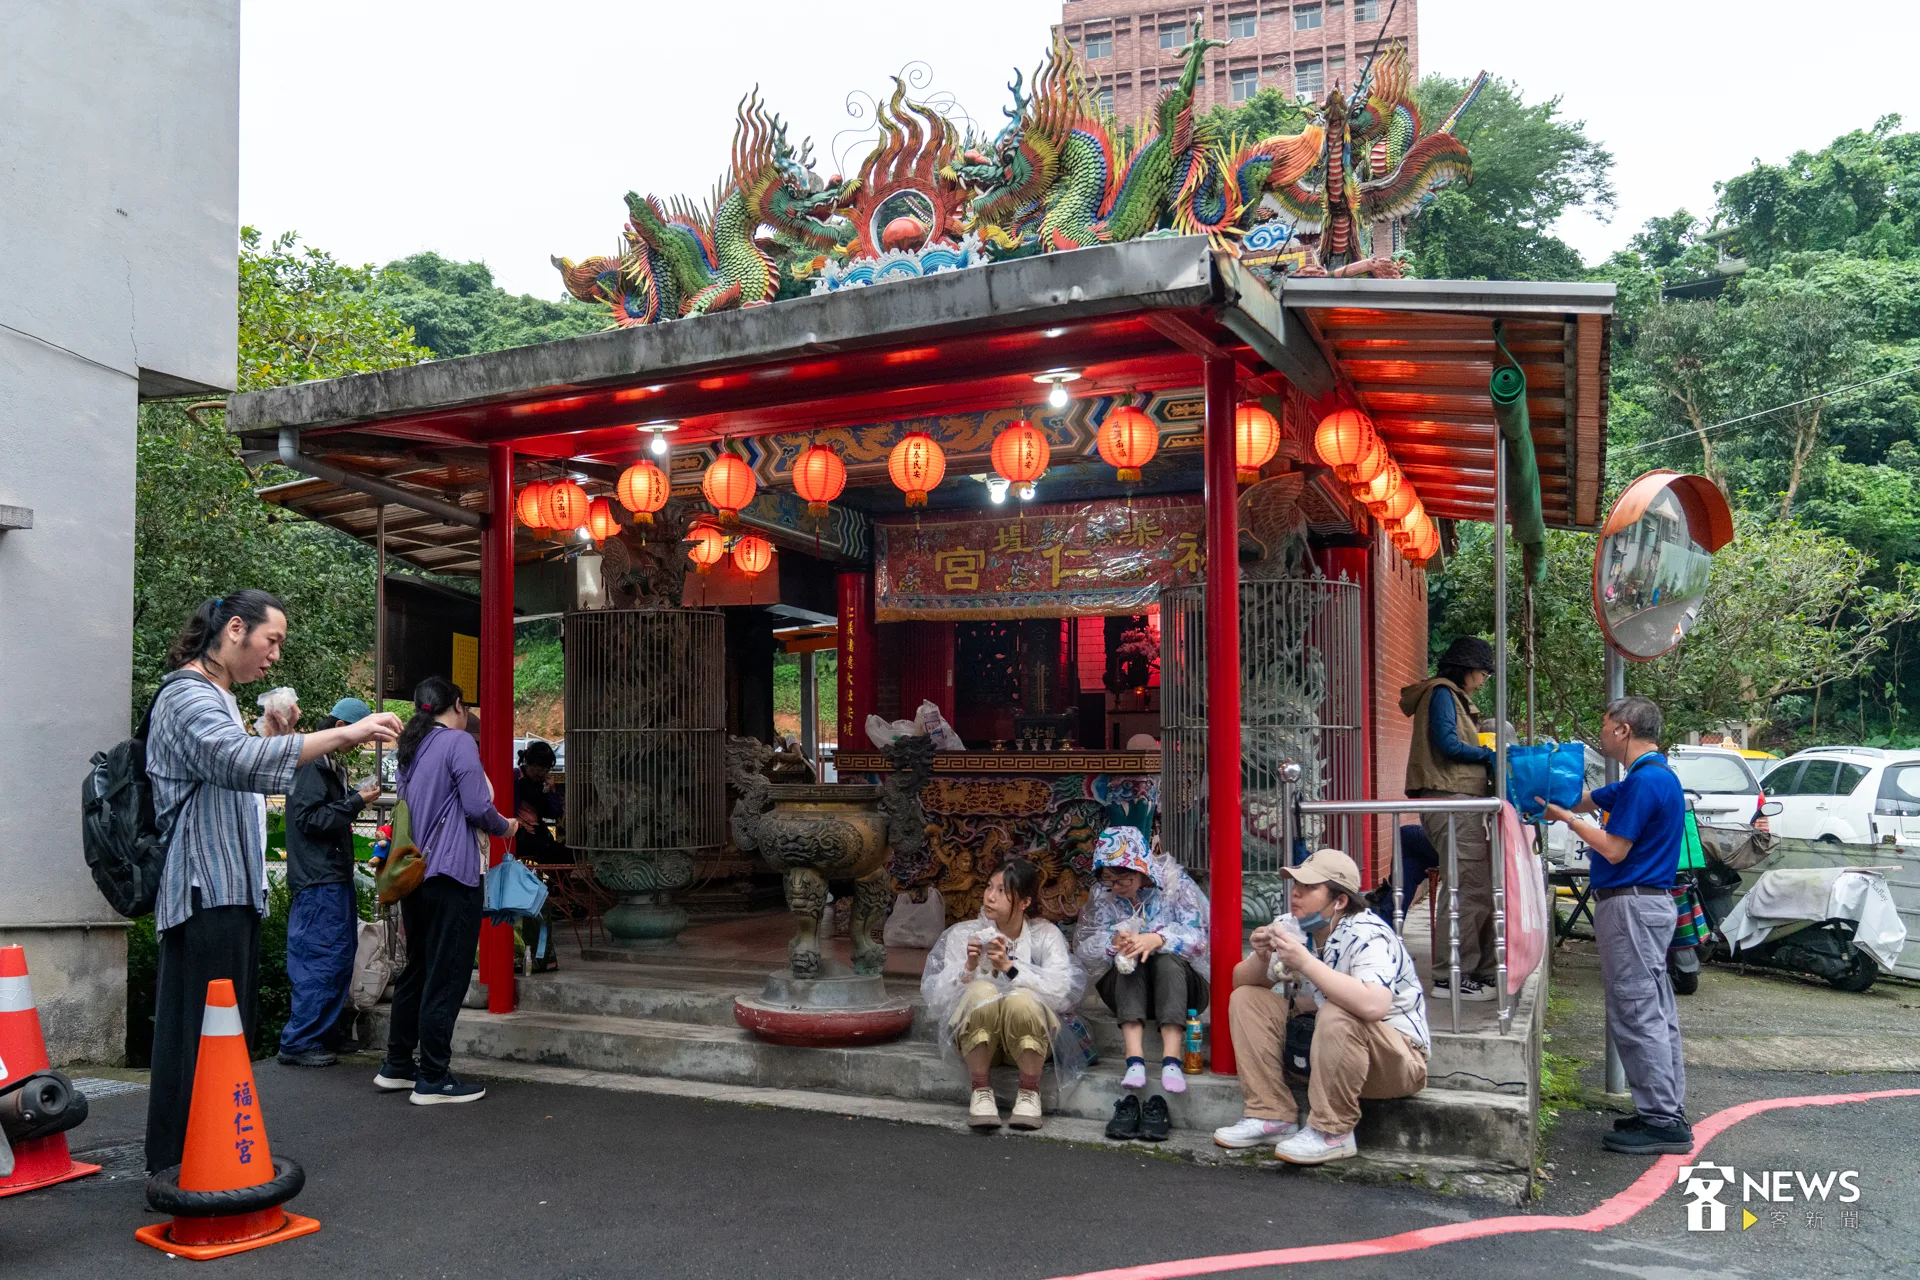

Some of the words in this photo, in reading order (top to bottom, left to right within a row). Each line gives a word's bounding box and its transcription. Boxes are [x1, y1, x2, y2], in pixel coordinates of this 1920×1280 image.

[913, 442, 922, 479] 國泰民安
[1023, 431, 1034, 470] 國泰民安
[1022, 726, 1057, 739] 福仁宮
[232, 1081, 255, 1165] 福仁宮
